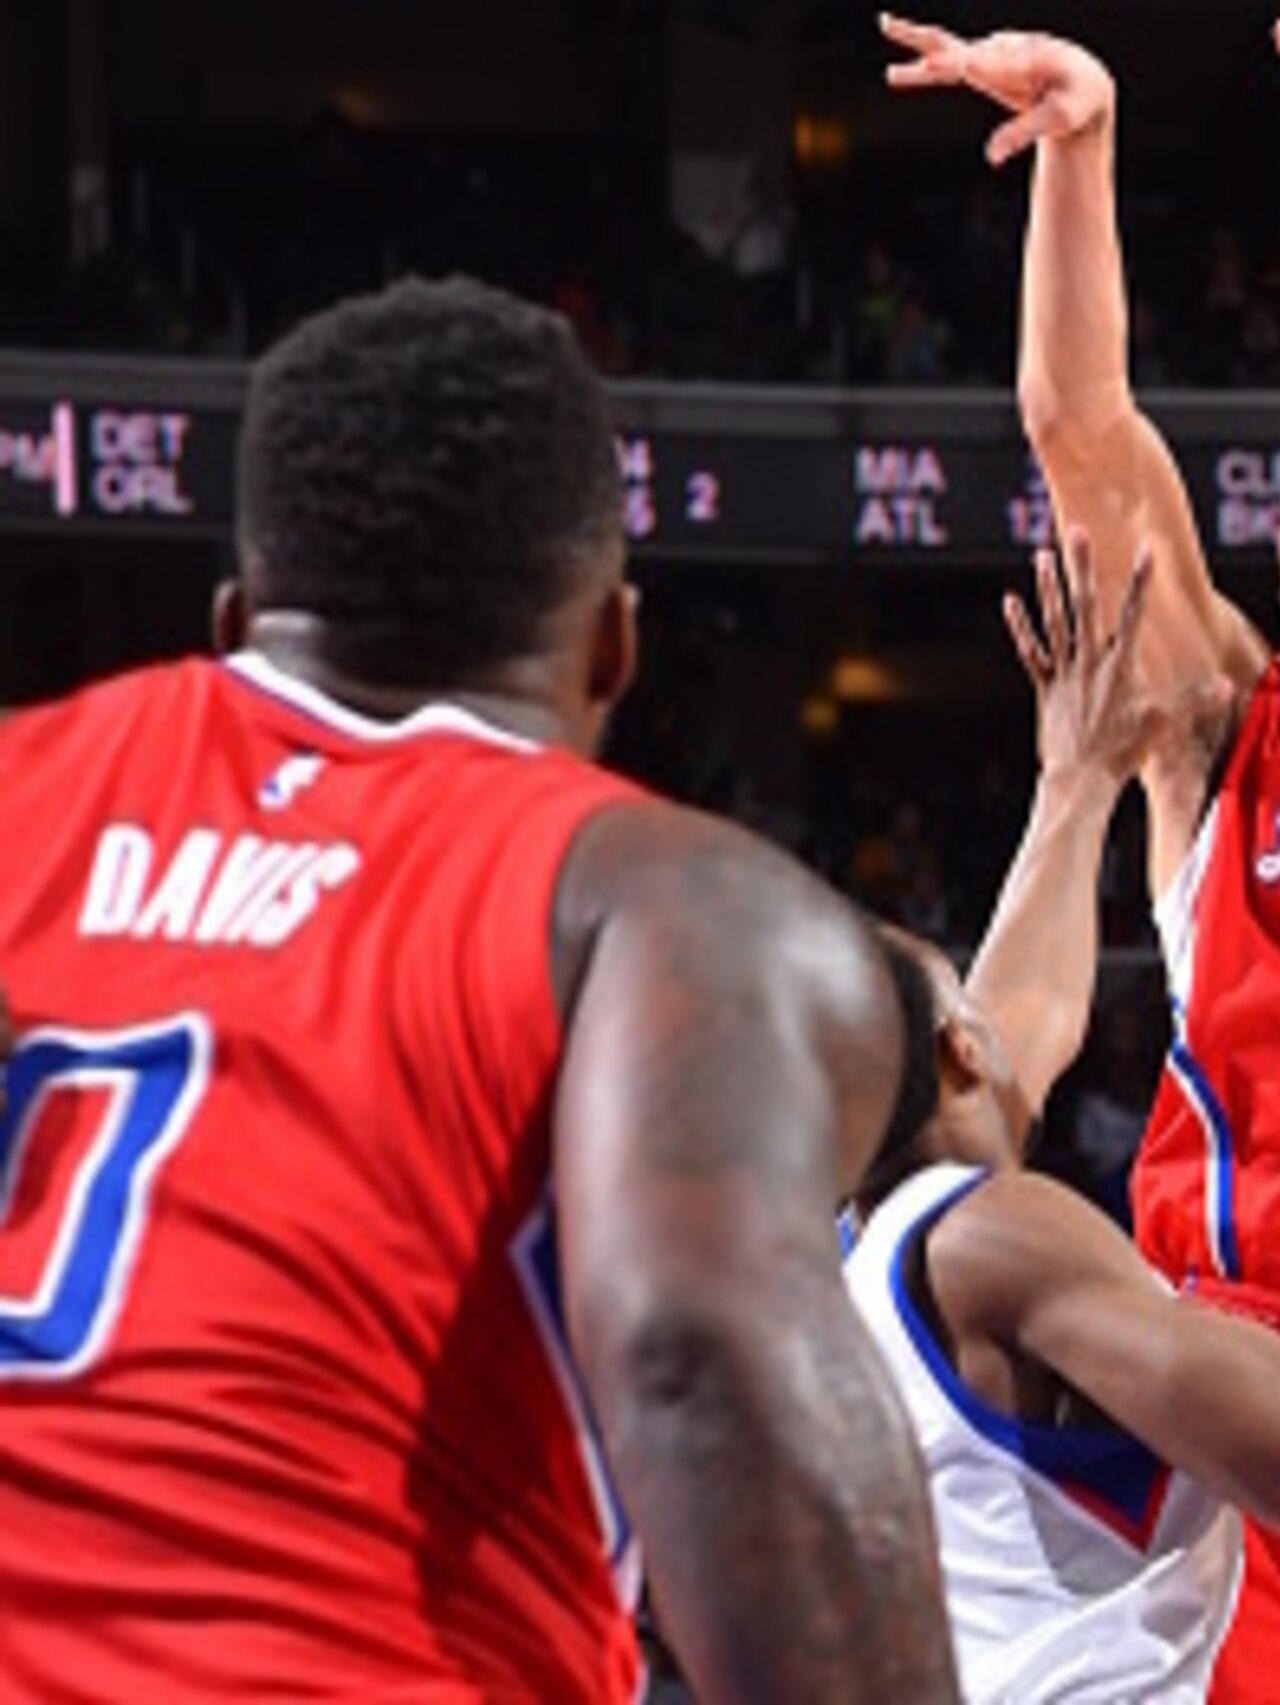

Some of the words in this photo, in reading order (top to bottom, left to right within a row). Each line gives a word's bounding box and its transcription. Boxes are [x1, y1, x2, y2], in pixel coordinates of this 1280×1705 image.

[90, 412, 189, 461] DET
[93, 462, 193, 514] ORL
[855, 446, 948, 494] MIA
[685, 470, 720, 521] 2
[856, 497, 948, 545] ATL
[76, 821, 362, 947] DAVIS
